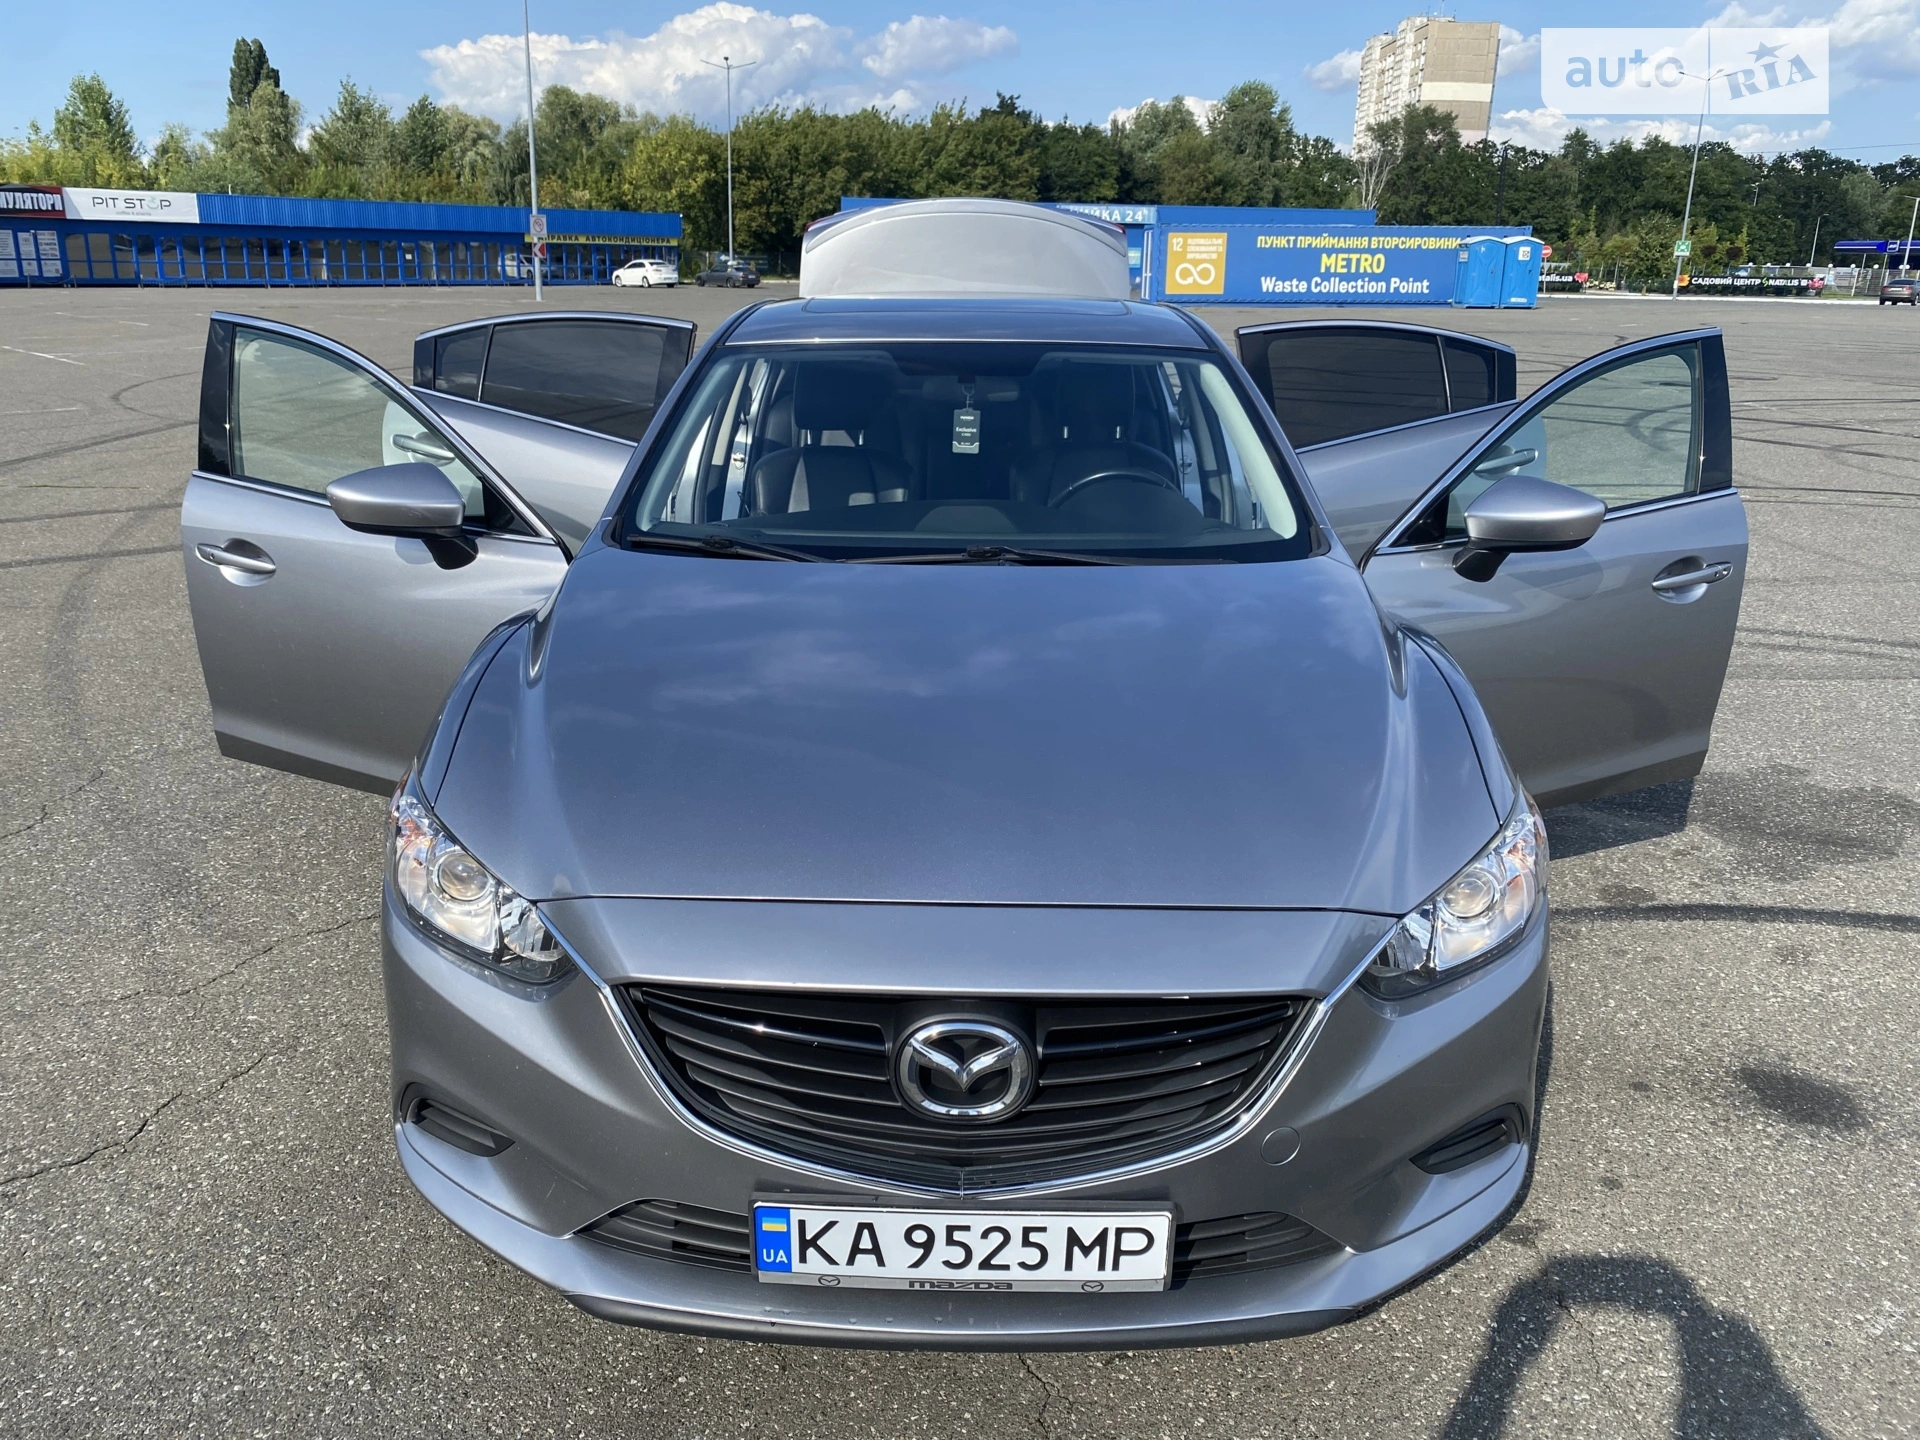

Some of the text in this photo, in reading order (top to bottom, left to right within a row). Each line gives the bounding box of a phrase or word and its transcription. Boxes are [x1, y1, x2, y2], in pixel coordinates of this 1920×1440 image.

[92, 196, 119, 208] PIT
[1172, 237, 1184, 252] 12
[1257, 233, 1461, 250] ПУНКТ ПРИЙМАННЯ ВТОРСИРОВИНИ
[1320, 253, 1385, 273] METRO
[1261, 276, 1430, 294] Waste Collection Point
[1691, 277, 1733, 286] САДОВИЙ
[1733, 278, 1761, 287] ЦЕНТР
[797, 1218, 1155, 1272] KA 9525 MP
[762, 1248, 788, 1264] UA
